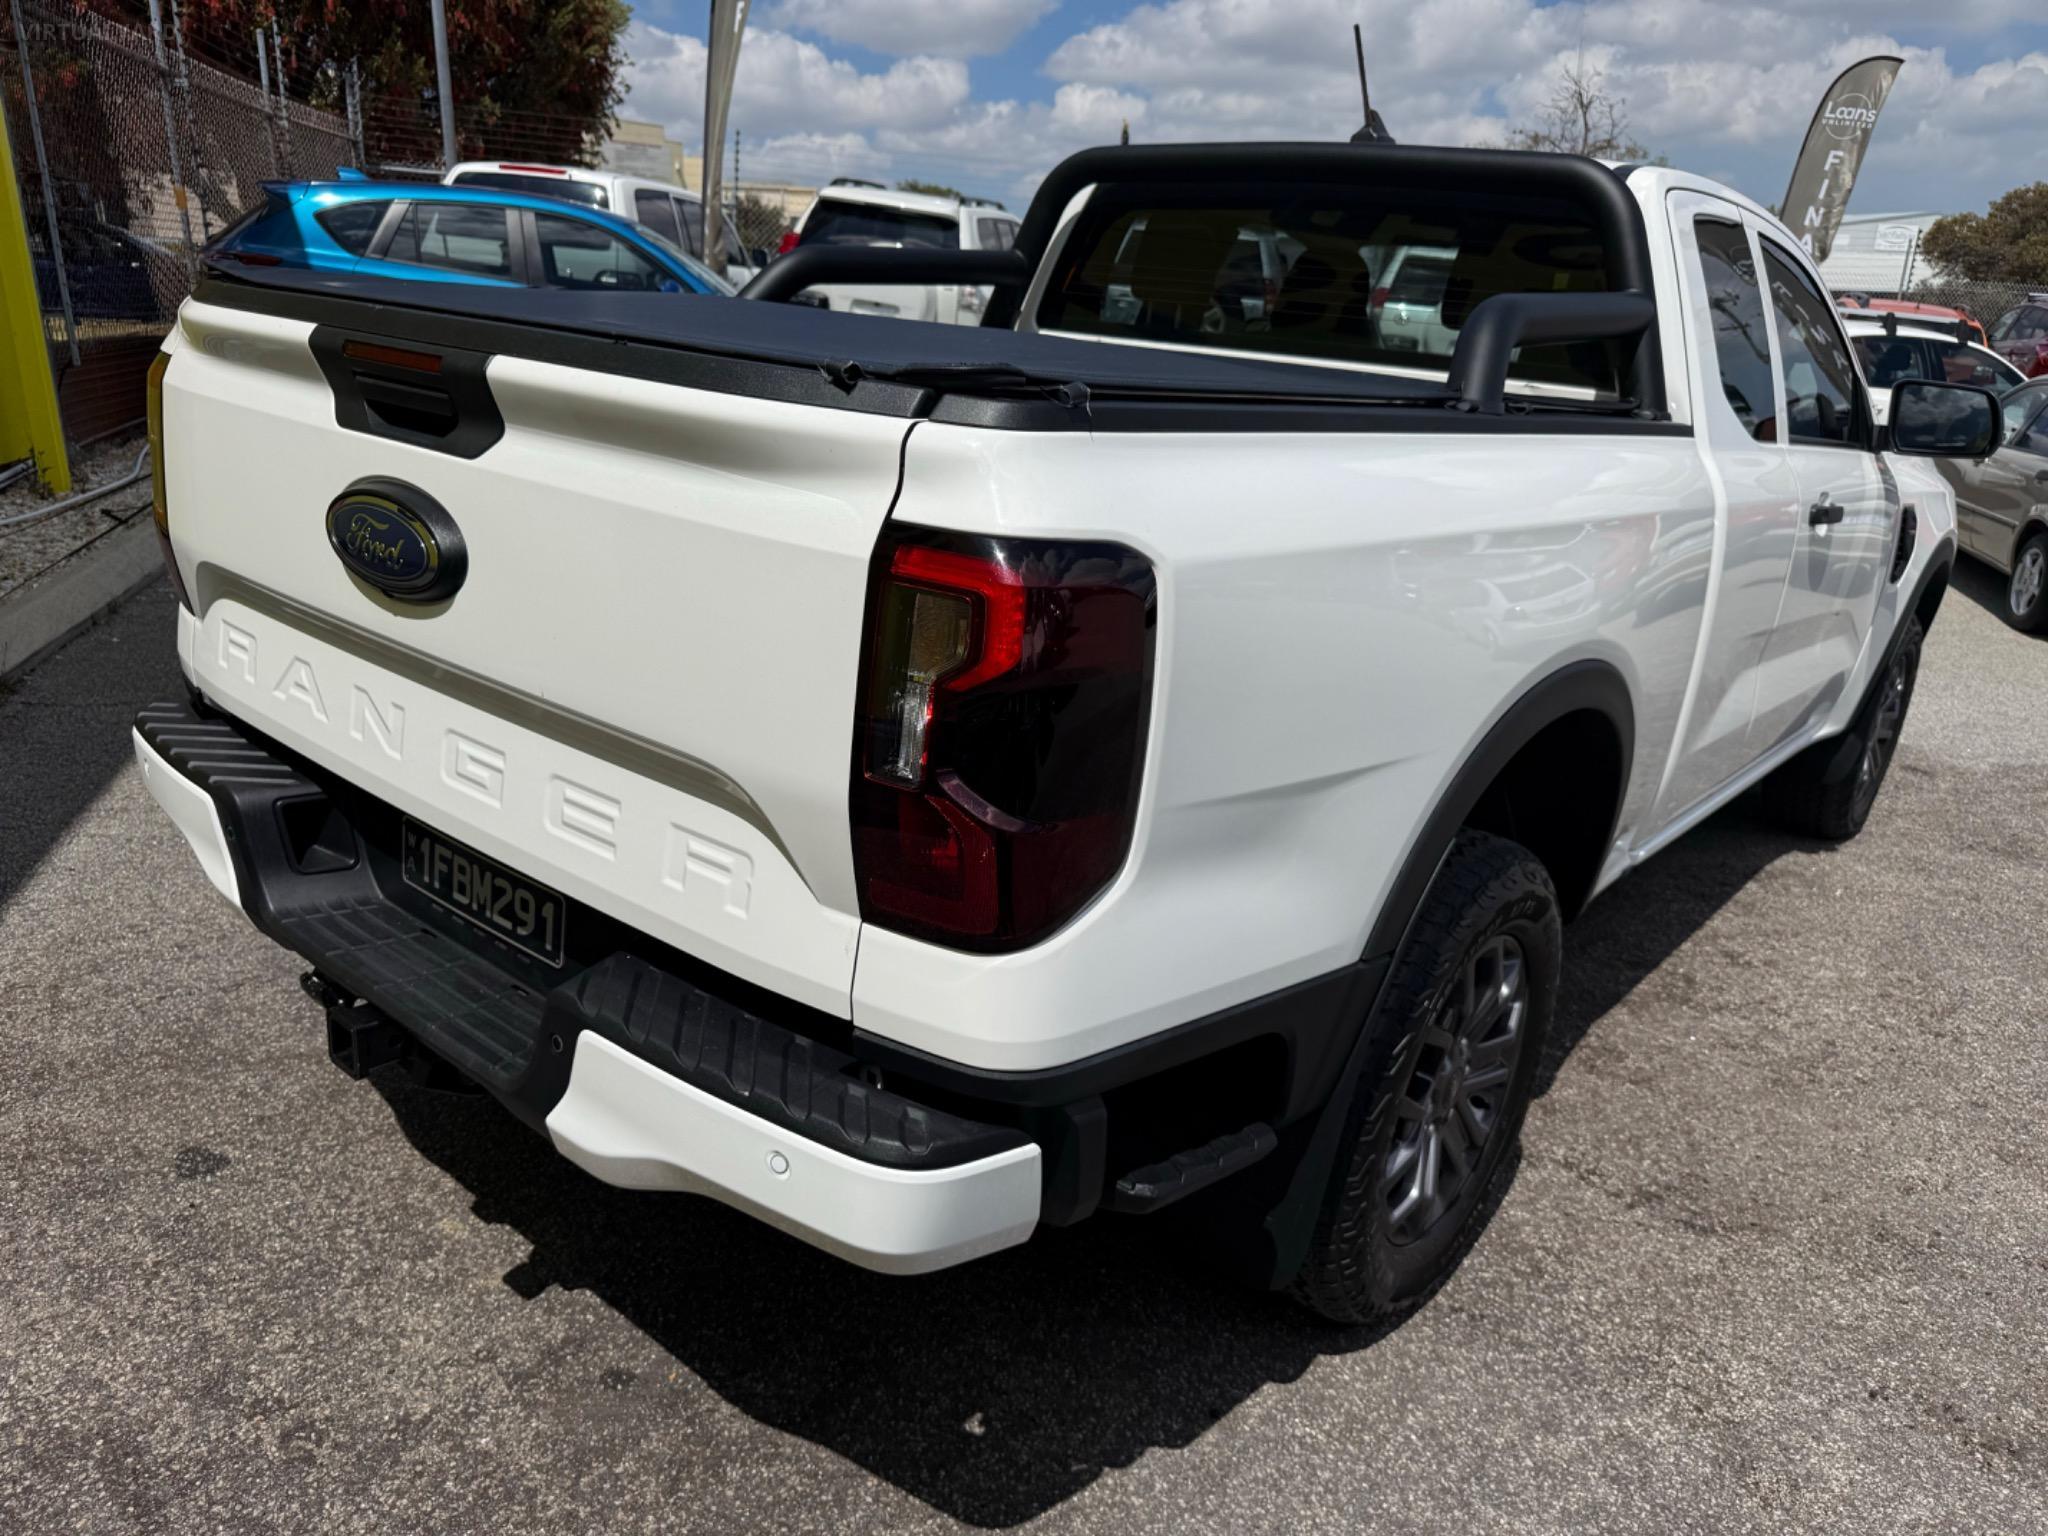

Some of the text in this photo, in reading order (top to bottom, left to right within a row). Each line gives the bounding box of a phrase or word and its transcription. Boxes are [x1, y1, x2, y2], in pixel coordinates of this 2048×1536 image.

[1824, 100, 1877, 123] Loans
[345, 512, 405, 570] Ford
[217, 618, 755, 919] RANGER
[420, 837, 555, 952] 1FBM291
